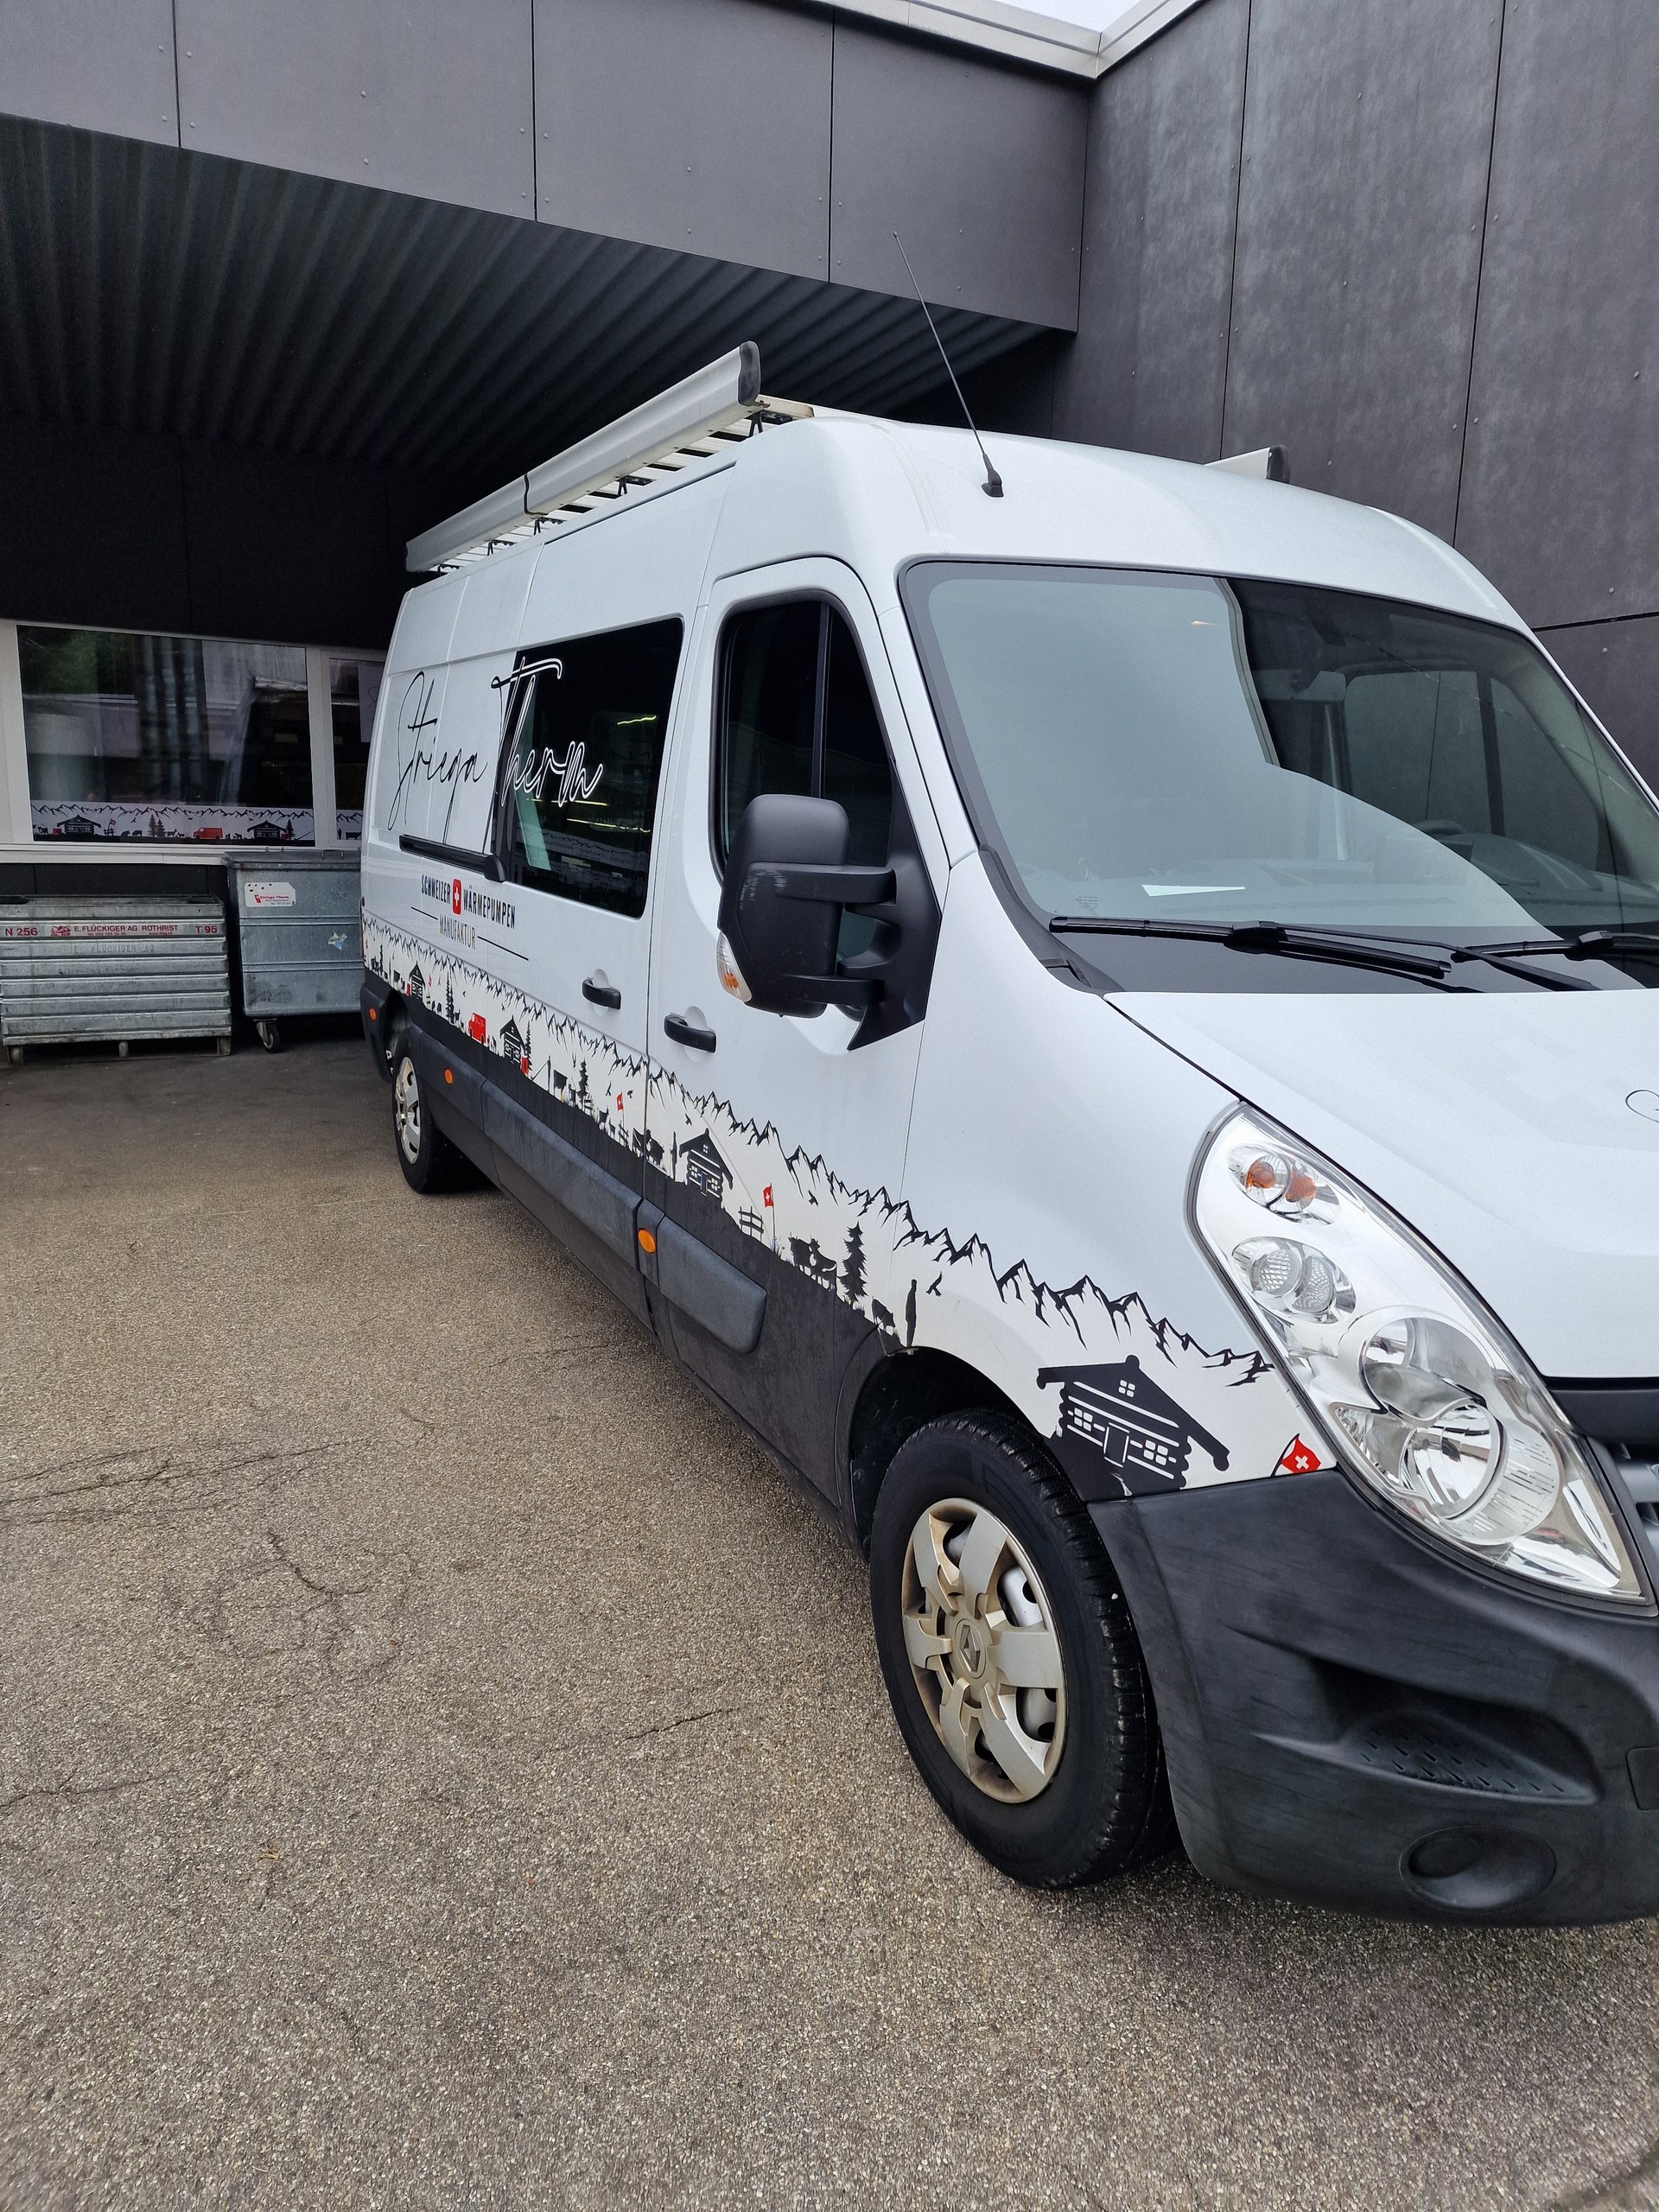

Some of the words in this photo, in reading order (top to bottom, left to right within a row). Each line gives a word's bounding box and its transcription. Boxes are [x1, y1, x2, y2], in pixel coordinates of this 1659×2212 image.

[482, 656, 603, 854] Therm
[421, 874, 451, 905] SCHWEIZER
[463, 884, 516, 930] WÄRMEPUMPEN
[4, 927, 13, 937] N
[16, 927, 38, 937] 256
[439, 913, 476, 950] MANUFAKTUR
